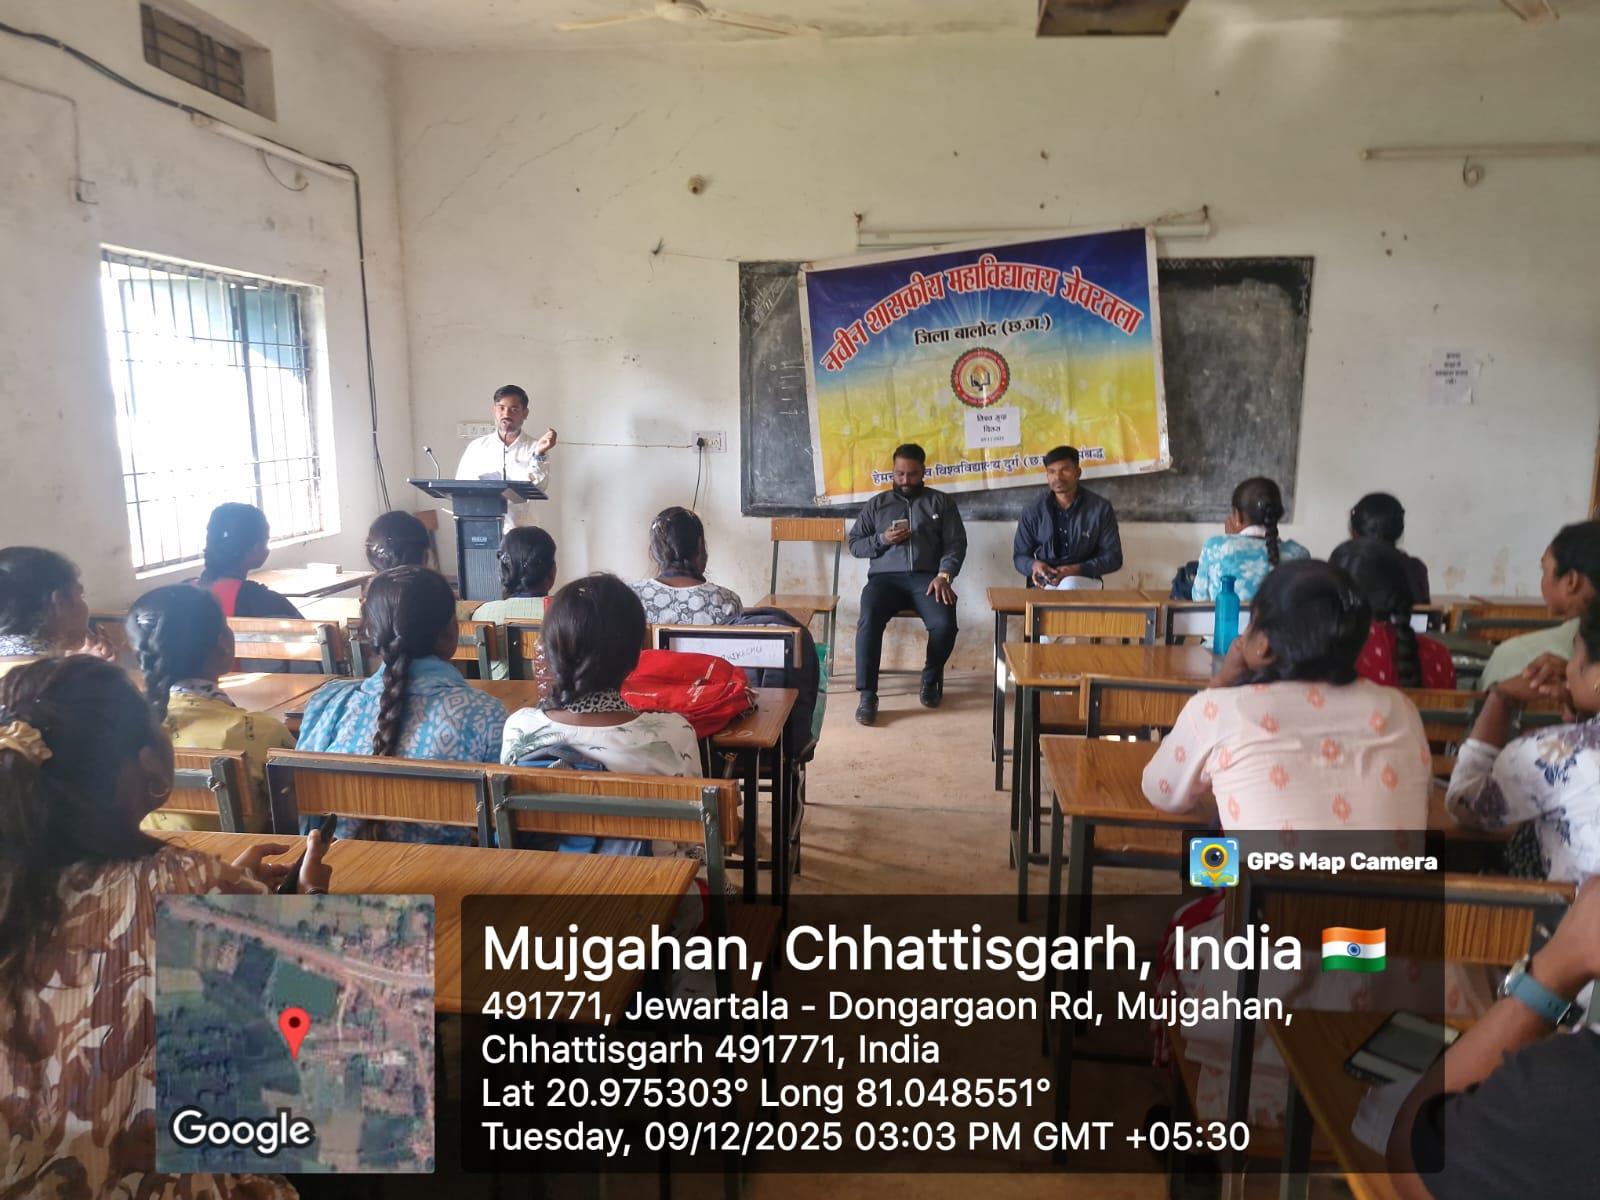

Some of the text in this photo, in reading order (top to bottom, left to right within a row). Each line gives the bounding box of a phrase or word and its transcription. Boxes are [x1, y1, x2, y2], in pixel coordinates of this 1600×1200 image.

[820, 254, 1145, 373] नवीन शासकीय महाविद्यालय जेवरतला
[914, 314, 1052, 345] जिला बालोद (छ.ग.)
